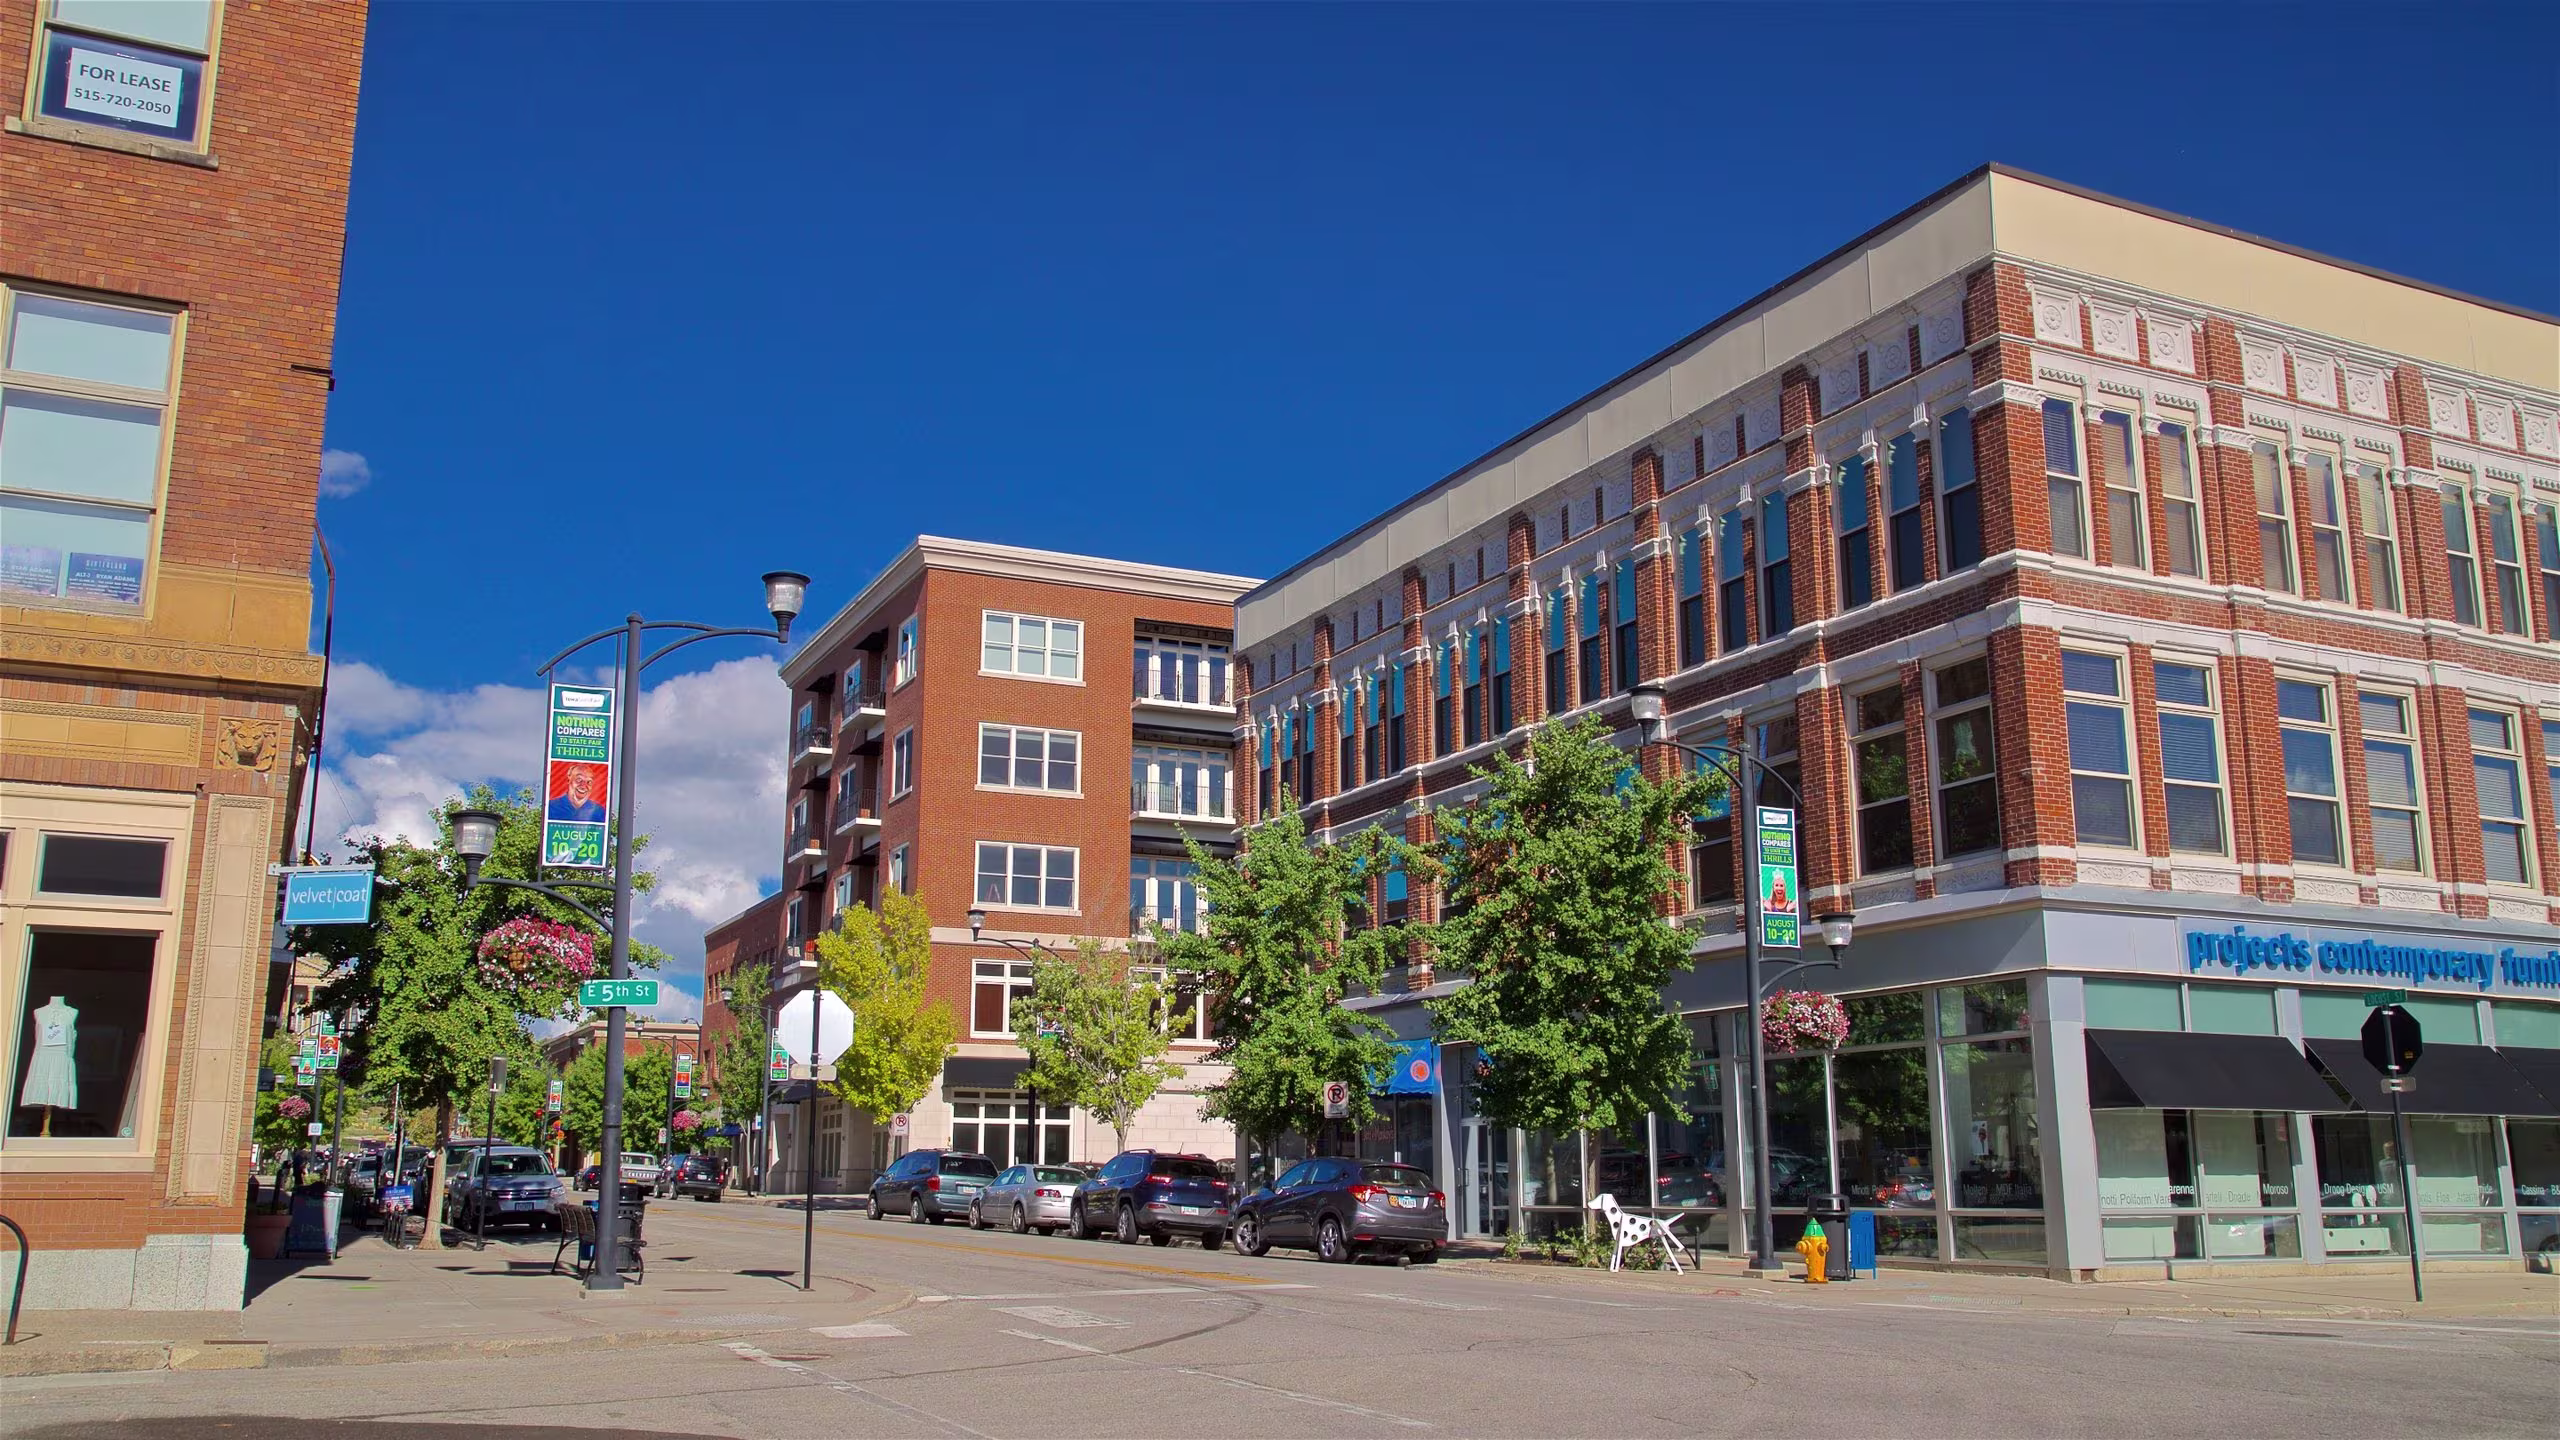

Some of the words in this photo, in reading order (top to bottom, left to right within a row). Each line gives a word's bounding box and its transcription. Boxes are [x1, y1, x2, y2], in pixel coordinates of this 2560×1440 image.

[80, 64, 115, 82] FOR
[120, 72, 171, 92] LEASE
[74, 87, 171, 115] 515-720-2050
[557, 715, 606, 728] NOTHING
[557, 726, 605, 737] COMPARES
[556, 746, 605, 758] THRILLS
[552, 830, 599, 841] AUGUST
[1763, 854, 1792, 863] THRILLS
[1767, 919, 1795, 927] AUGUST
[2186, 925, 2313, 975] projects
[2317, 939, 2494, 991] contemporary
[588, 985, 596, 997] E
[602, 985, 629, 1002] 5th
[635, 985, 650, 996] St
[2262, 1183, 2289, 1195] Moroso
[2323, 1183, 2344, 1197] Droog
